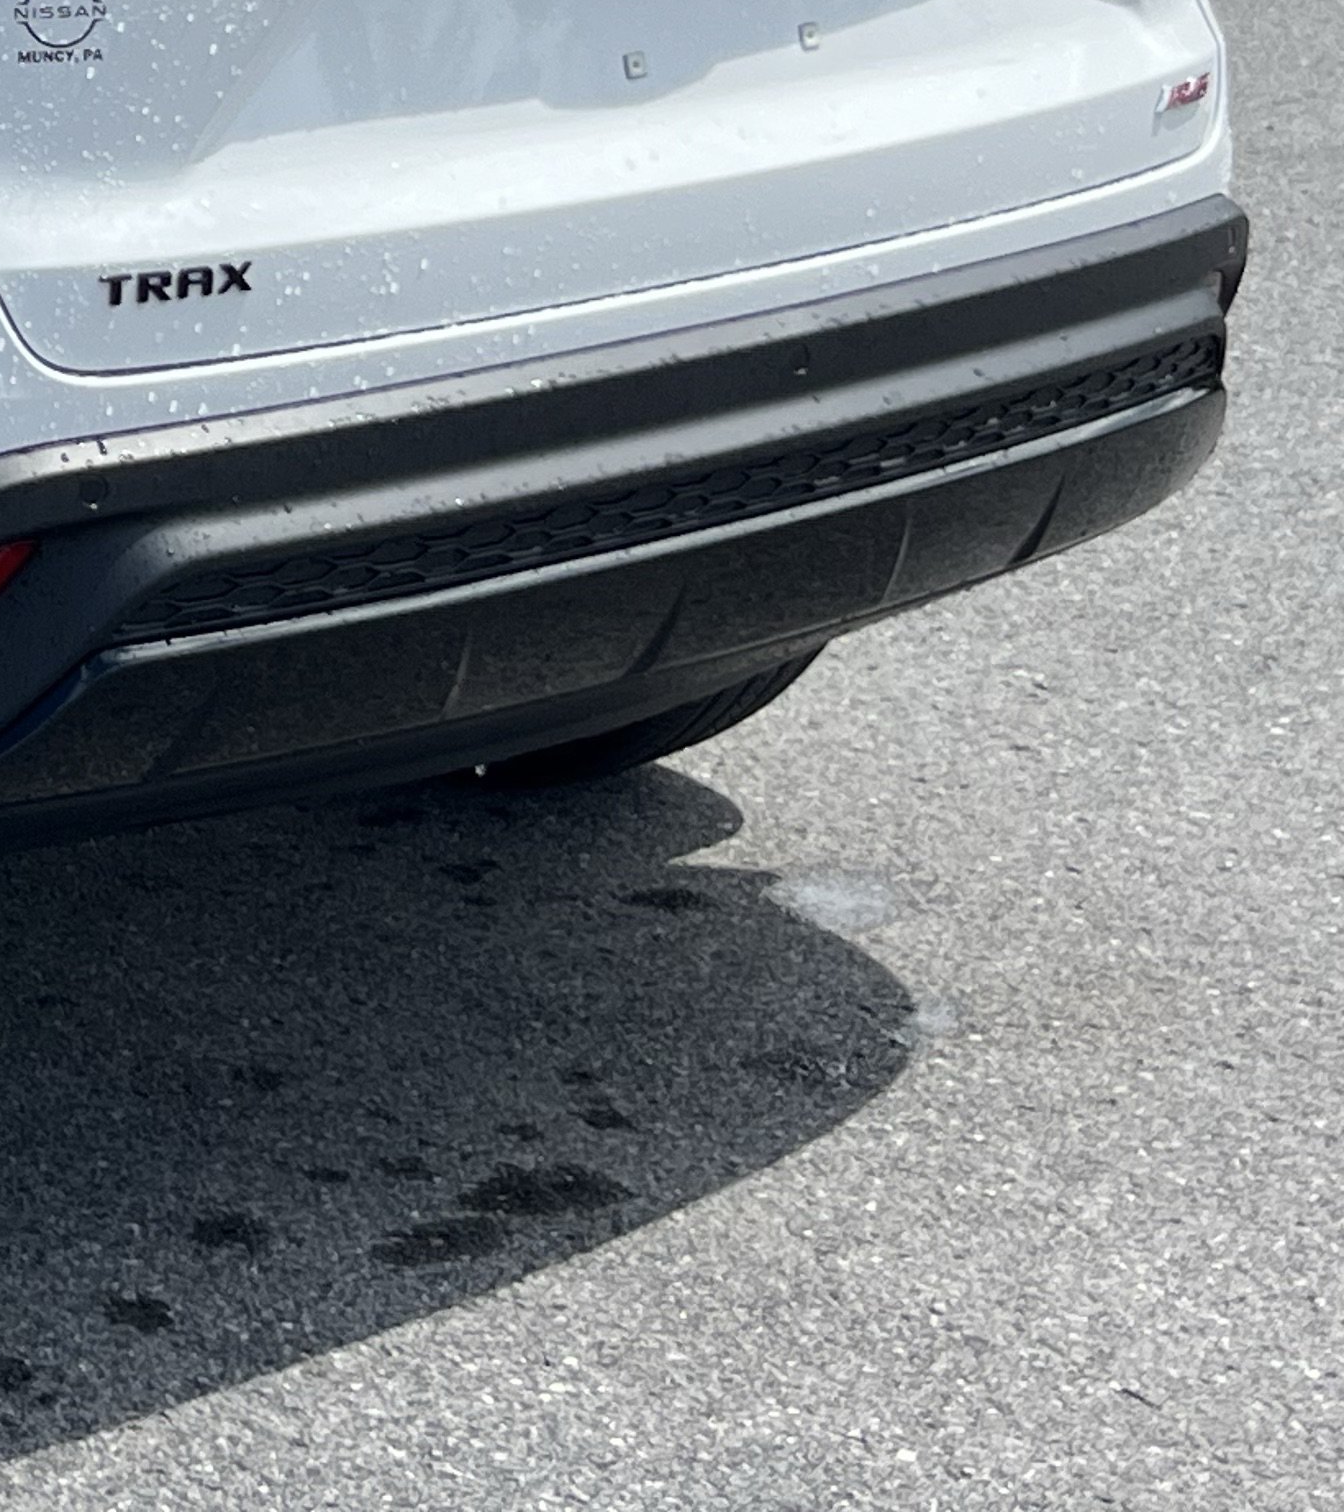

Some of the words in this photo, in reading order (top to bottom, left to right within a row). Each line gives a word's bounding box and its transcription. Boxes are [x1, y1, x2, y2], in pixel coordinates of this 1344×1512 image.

[14, 5, 106, 19] NISSAN
[17, 50, 79, 63] MUNCY,
[83, 49, 103, 61] PA
[98, 261, 252, 306] TRAX
